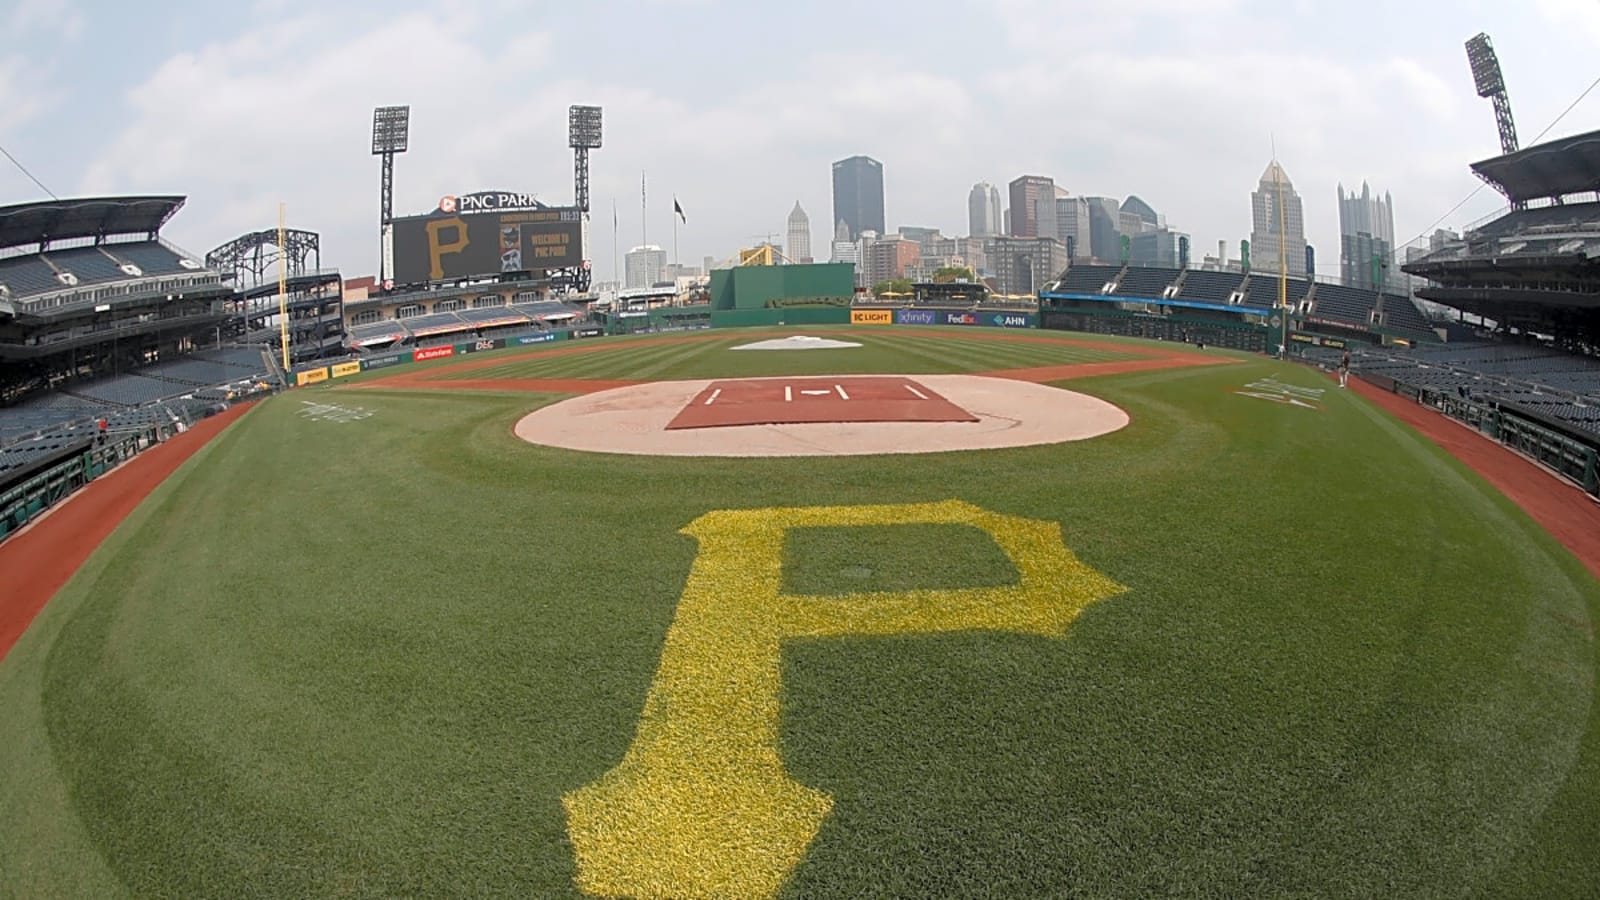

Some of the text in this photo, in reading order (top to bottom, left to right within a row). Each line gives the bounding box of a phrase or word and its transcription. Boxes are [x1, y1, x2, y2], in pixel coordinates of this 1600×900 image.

[460, 193, 538, 209] PNC PARK
[531, 234, 560, 245] WELCOME
[425, 216, 470, 280] P
[901, 312, 932, 323] xfinity
[947, 314, 975, 323] FedEx
[1004, 317, 1025, 325] AHN
[562, 498, 1131, 900] P
